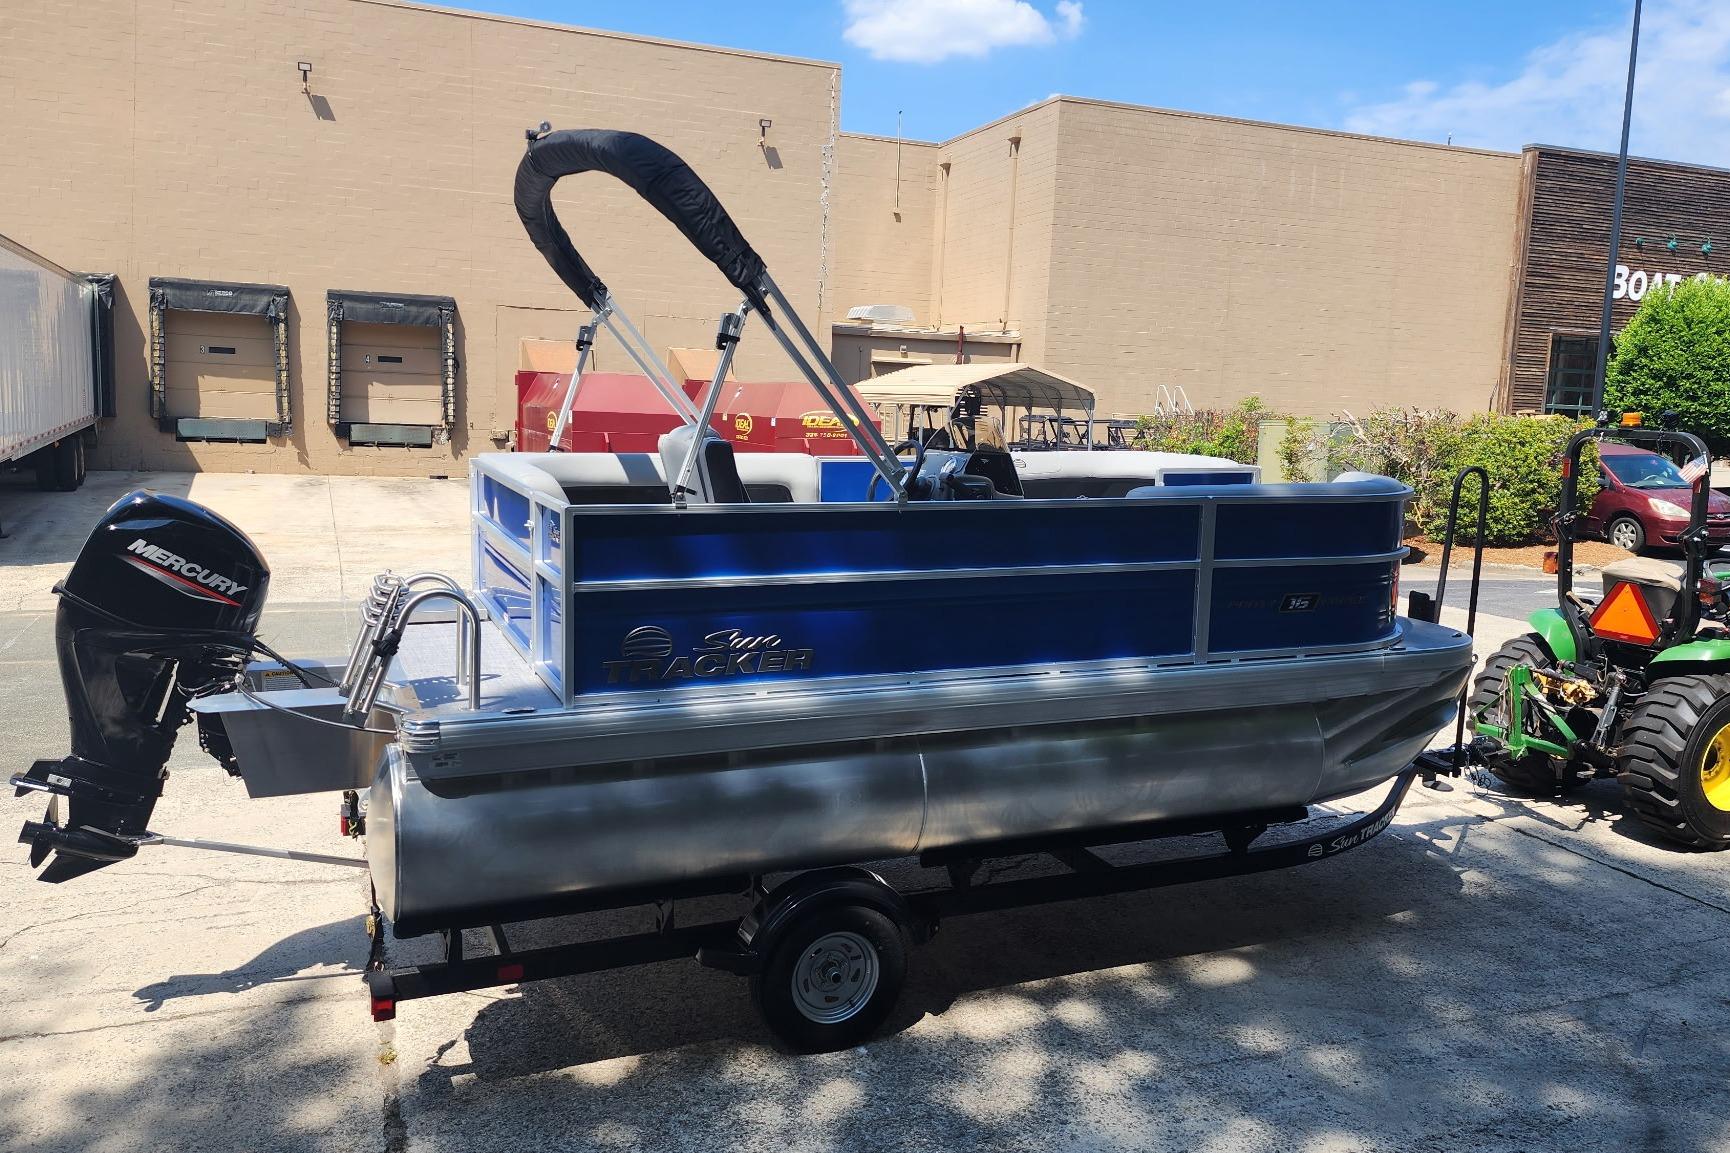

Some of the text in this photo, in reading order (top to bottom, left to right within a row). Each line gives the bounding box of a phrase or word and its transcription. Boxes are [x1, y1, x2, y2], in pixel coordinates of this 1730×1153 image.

[1612, 264, 1682, 302] BOAT
[802, 415, 843, 426] IDEA
[127, 539, 248, 595] MERCURY
[693, 629, 781, 651] Sun
[602, 649, 814, 683] TRACKER
[1329, 805, 1396, 853] Sun TRACKER
